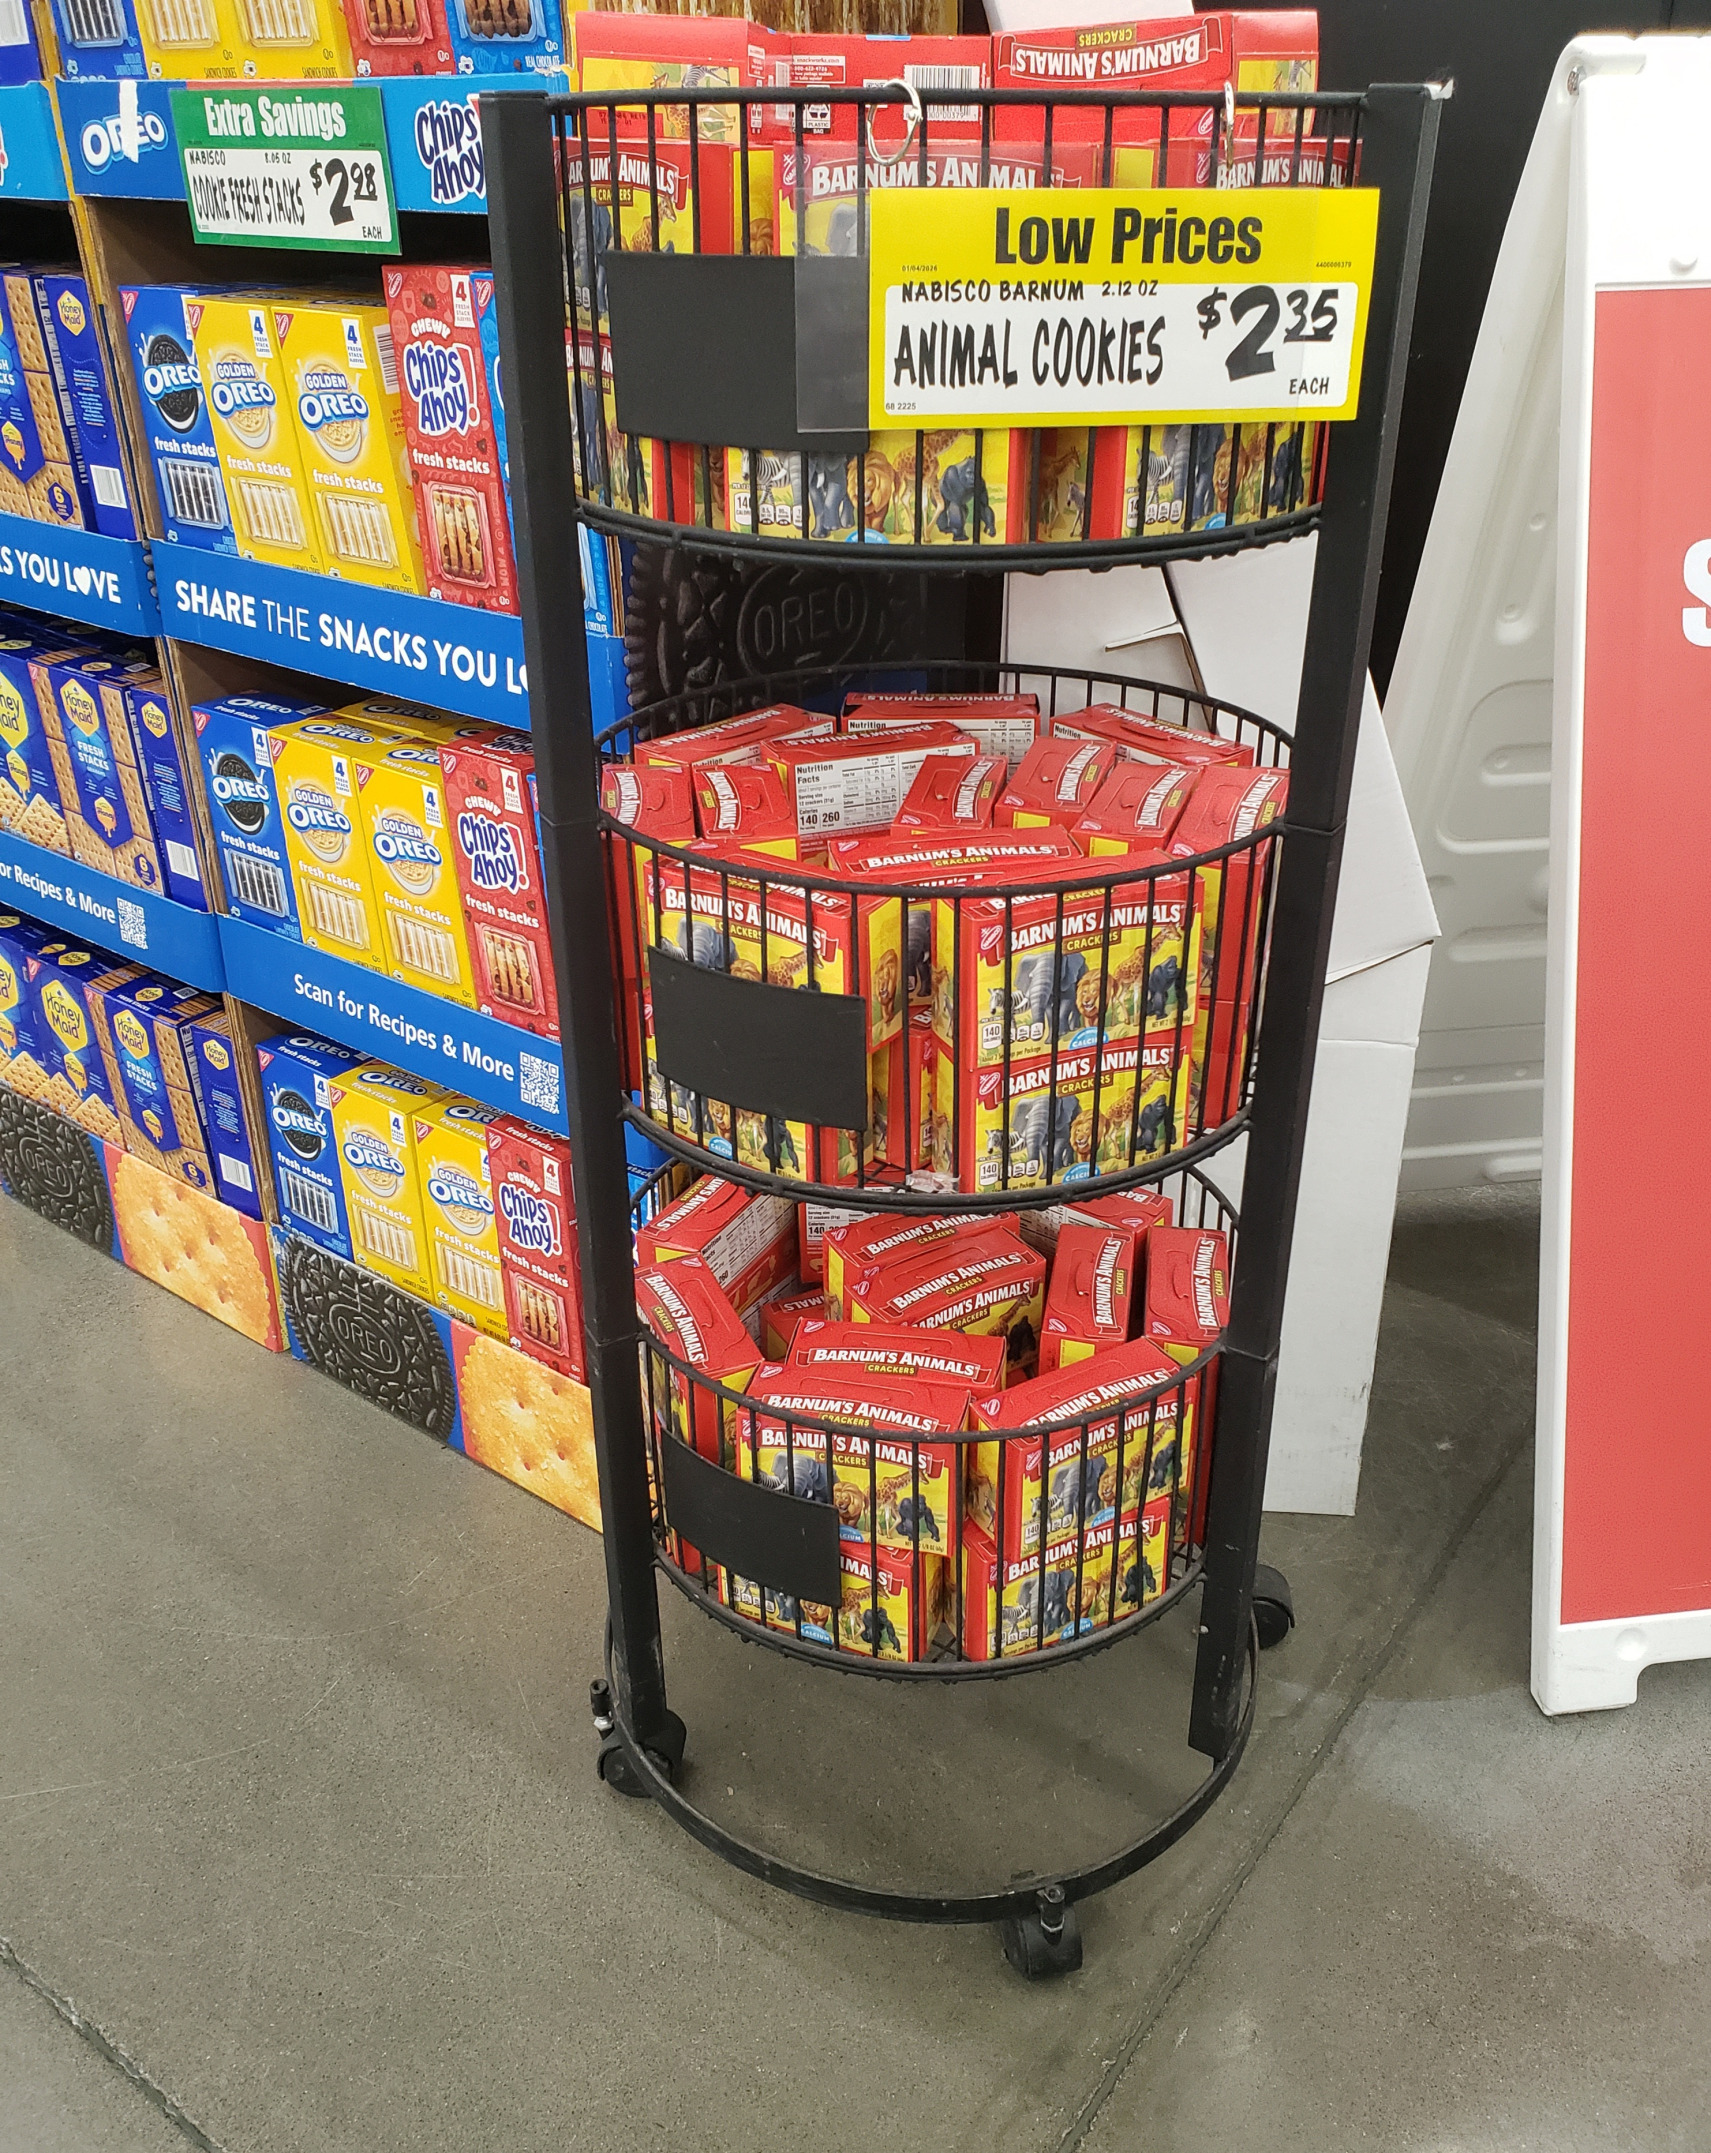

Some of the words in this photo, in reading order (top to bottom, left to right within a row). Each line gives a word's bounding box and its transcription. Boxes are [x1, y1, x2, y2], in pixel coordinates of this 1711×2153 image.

[1078, 24, 1134, 47] CRACKERS
[1016, 49, 1098, 79] ANIMALS
[1100, 33, 1200, 76] BARNUM'S
[205, 97, 255, 137] Extra
[258, 96, 347, 141] Savings
[417, 103, 478, 165] Chips
[190, 150, 226, 166] NABISCO
[433, 141, 484, 200] Ahoy
[193, 175, 230, 222] COOKIE
[228, 176, 264, 225] FRESH
[262, 176, 305, 226] STACKS
[362, 226, 382, 240] EACH
[995, 207, 1096, 264] Low
[1111, 207, 1263, 264] Prices
[901, 264, 938, 273] 01/04/2026
[455, 280, 467, 302] 4
[901, 279, 991, 303] NABISCO
[999, 279, 1085, 302] BARNUM
[1101, 281, 1135, 297] 2.12
[1138, 281, 1159, 297] OZ
[253, 316, 263, 334] 4
[346, 325, 358, 345] 4
[411, 319, 452, 338] CHEWY
[893, 318, 1018, 389] ANIMAL
[1031, 315, 1166, 387] COOKIES
[144, 364, 202, 396] OREO
[217, 363, 255, 378] GOLDEN
[306, 372, 347, 390] GOLDEN
[404, 344, 461, 394] Chips
[213, 382, 274, 410] OREO
[1289, 377, 1329, 396] EACH
[301, 394, 368, 425] OREO
[897, 402, 917, 411] 2225
[155, 436, 181, 453] fresh
[181, 441, 216, 459] stacks
[226, 455, 254, 472] fresh
[256, 461, 292, 480] stacks
[412, 448, 445, 469] fresh
[446, 455, 490, 475] stacks
[312, 469, 343, 487] fresh
[344, 475, 384, 495] stacks
[18, 549, 60, 588] YOU
[175, 580, 257, 629] SHARE
[262, 598, 311, 643] THE
[318, 612, 427, 672] SNACKS
[432, 638, 497, 688] YOU
[64, 692, 93, 713] Honey
[227, 697, 292, 715] OREO
[70, 706, 93, 725] Maid
[850, 721, 887, 730] Nutrition
[77, 740, 104, 758] FRESH
[255, 734, 265, 749] 4
[78, 752, 110, 771] STACKS
[335, 762, 345, 777] 4
[797, 763, 834, 775] Nutrition
[212, 776, 268, 801] OREO
[505, 776, 515, 792] 4
[798, 775, 820, 785] Facts
[295, 789, 332, 809] GOLDEN
[426, 792, 436, 808] 4
[465, 796, 502, 816] CHEWY
[289, 803, 350, 831] OREO
[382, 818, 423, 838] GOLDEN
[800, 814, 818, 826] 140
[822, 811, 840, 823] 260
[221, 831, 247, 852] fresh
[246, 839, 280, 861] stacks
[459, 813, 511, 857] Chips
[375, 833, 441, 862] OREO
[867, 846, 964, 868] BARNUM'S
[966, 843, 1053, 857] ANIMALS
[935, 856, 990, 867] CRACKERS
[298, 860, 327, 882] fresh
[327, 869, 361, 893] stacks
[0, 862, 13, 878] or
[14, 864, 63, 901] Recipes
[65, 888, 77, 907] &
[79, 892, 116, 925] More
[384, 891, 414, 912] fresh
[414, 902, 451, 926] stacks
[466, 893, 496, 917] fresh
[495, 904, 540, 929] stacks
[45, 991, 80, 1023] Honey
[51, 1012, 80, 1040] Maid
[117, 1015, 148, 1043] Honey
[294, 973, 333, 1004] Scan
[337, 990, 365, 1020] for
[368, 1002, 437, 1052] Recipes
[443, 1036, 457, 1058] &
[462, 1042, 515, 1082] More
[985, 1027, 1001, 1038] 140
[121, 1030, 147, 1052] Maid
[288, 1036, 350, 1060] OREO
[126, 1061, 152, 1079] FRESH
[127, 1069, 156, 1091] STACKS
[316, 1079, 326, 1093] 4
[360, 1072, 428, 1096] OREO
[273, 1110, 326, 1137] OREO
[391, 1118, 402, 1131] 4
[352, 1132, 388, 1152] GOLDEN
[277, 1152, 302, 1176] fresh
[301, 1163, 333, 1187] stacks
[346, 1145, 404, 1175] OREO
[546, 1165, 556, 1177] 4
[982, 1165, 997, 1175] 140
[438, 1168, 478, 1191] GOLDEN
[507, 1171, 542, 1194] CHEWY
[351, 1190, 380, 1213] fresh
[379, 1201, 412, 1225] stacks
[430, 1181, 494, 1213] OREO
[500, 1185, 548, 1227] Chips
[808, 1226, 825, 1236] 140
[917, 1229, 956, 1245] CRACKERS
[435, 1227, 467, 1250] fresh
[466, 1239, 500, 1264] stacks
[502, 1247, 530, 1269] fresh
[529, 1260, 570, 1289] stacks
[1102, 1237, 1122, 1284] ANIMALS
[1199, 1237, 1216, 1285] ANIMALS
[893, 1274, 960, 1310] BARNUM'S
[958, 1253, 1021, 1281] ANIMALS
[945, 1275, 983, 1295] CRACKERS
[1115, 1268, 1125, 1295] CRACKERS
[1096, 1280, 1115, 1325] BARNUM'S
[1199, 1283, 1216, 1328] BARNUM'S
[951, 1306, 989, 1329] CRACKERS
[814, 1348, 897, 1364] BARNUM'S
[898, 1351, 979, 1377] ANIMALS
[867, 1364, 915, 1375] CRACKERS
[767, 1395, 854, 1414] BARNUM'S
[854, 1402, 937, 1431] ANIMALS
[821, 1414, 870, 1427] CRACKERS
